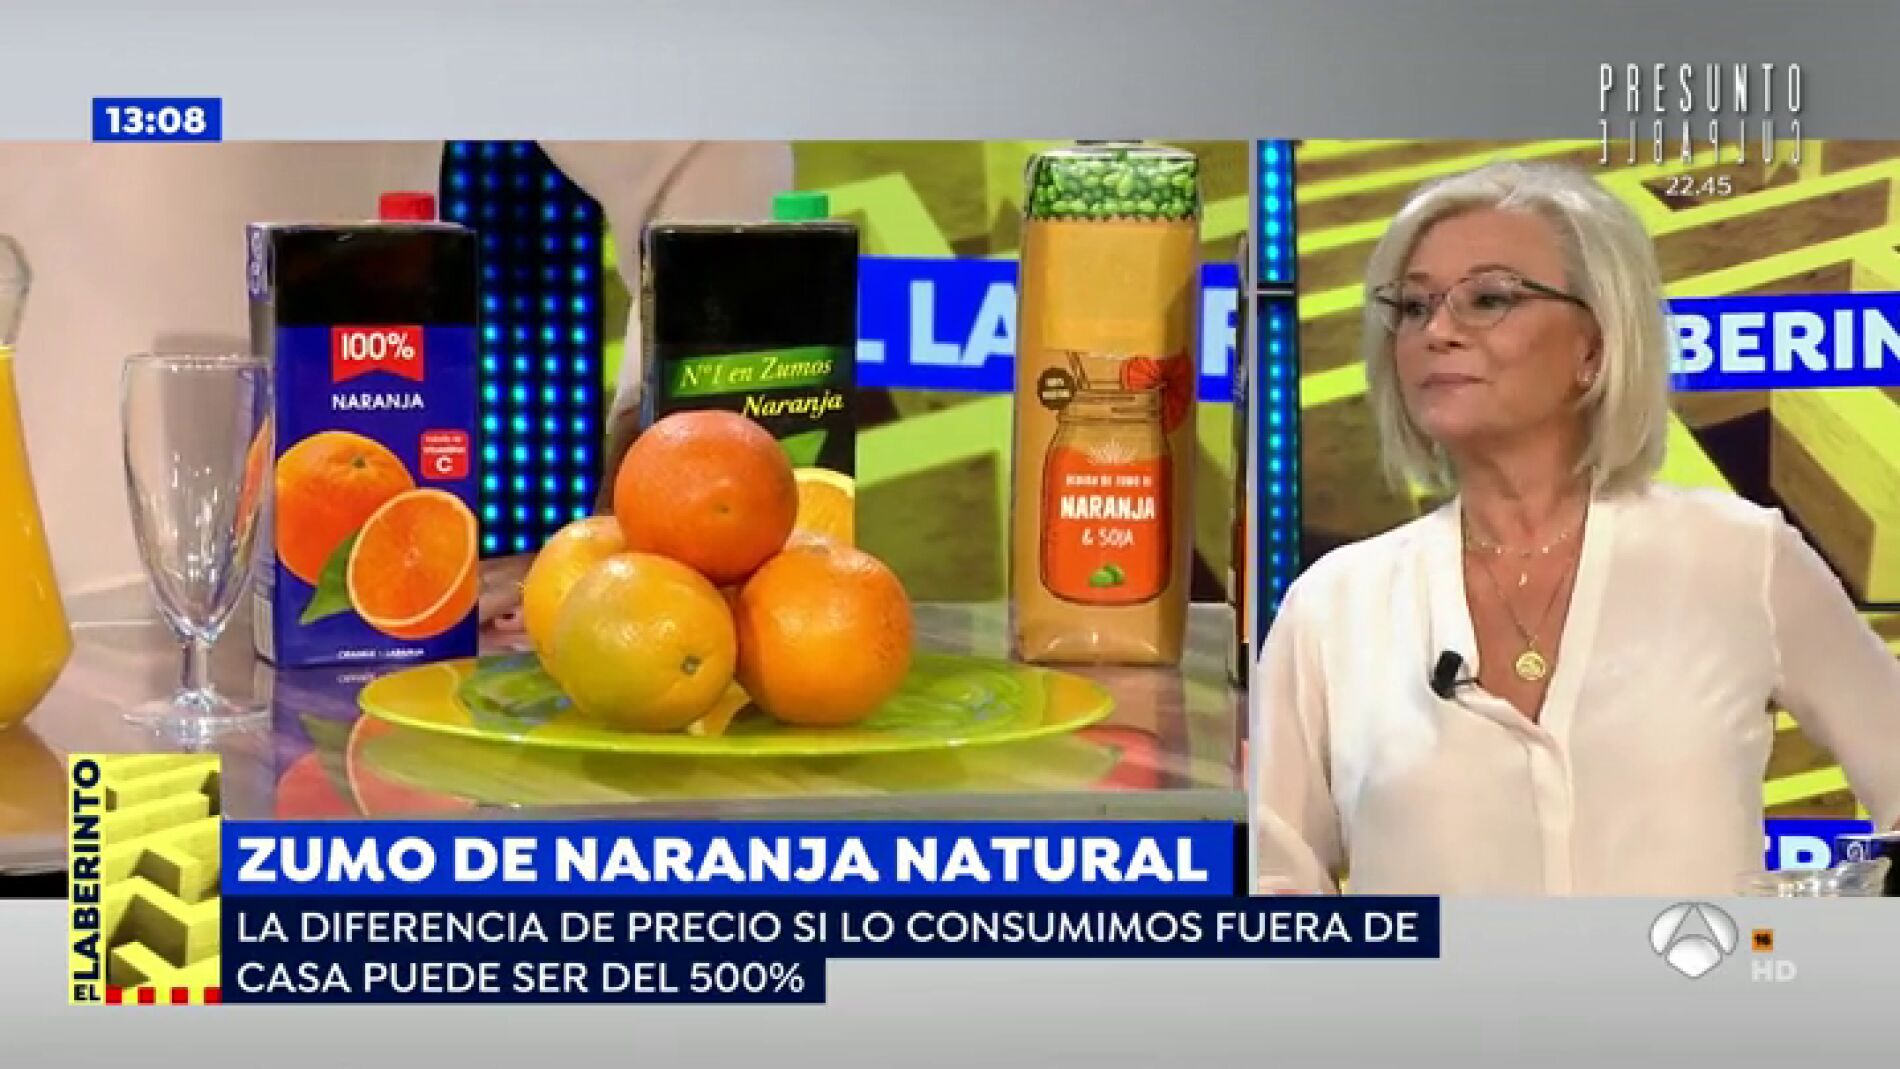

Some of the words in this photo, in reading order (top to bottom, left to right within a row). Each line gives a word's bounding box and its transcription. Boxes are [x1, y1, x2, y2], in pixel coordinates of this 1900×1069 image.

[342, 332, 417, 361] 100%
[728, 367, 752, 384] en
[759, 356, 833, 381] Zumos
[332, 393, 424, 411] NARANJA
[743, 389, 844, 419] Naranja
[434, 455, 453, 474] C
[1060, 495, 1155, 520] NARANJA
[1097, 527, 1134, 549] SOJA
